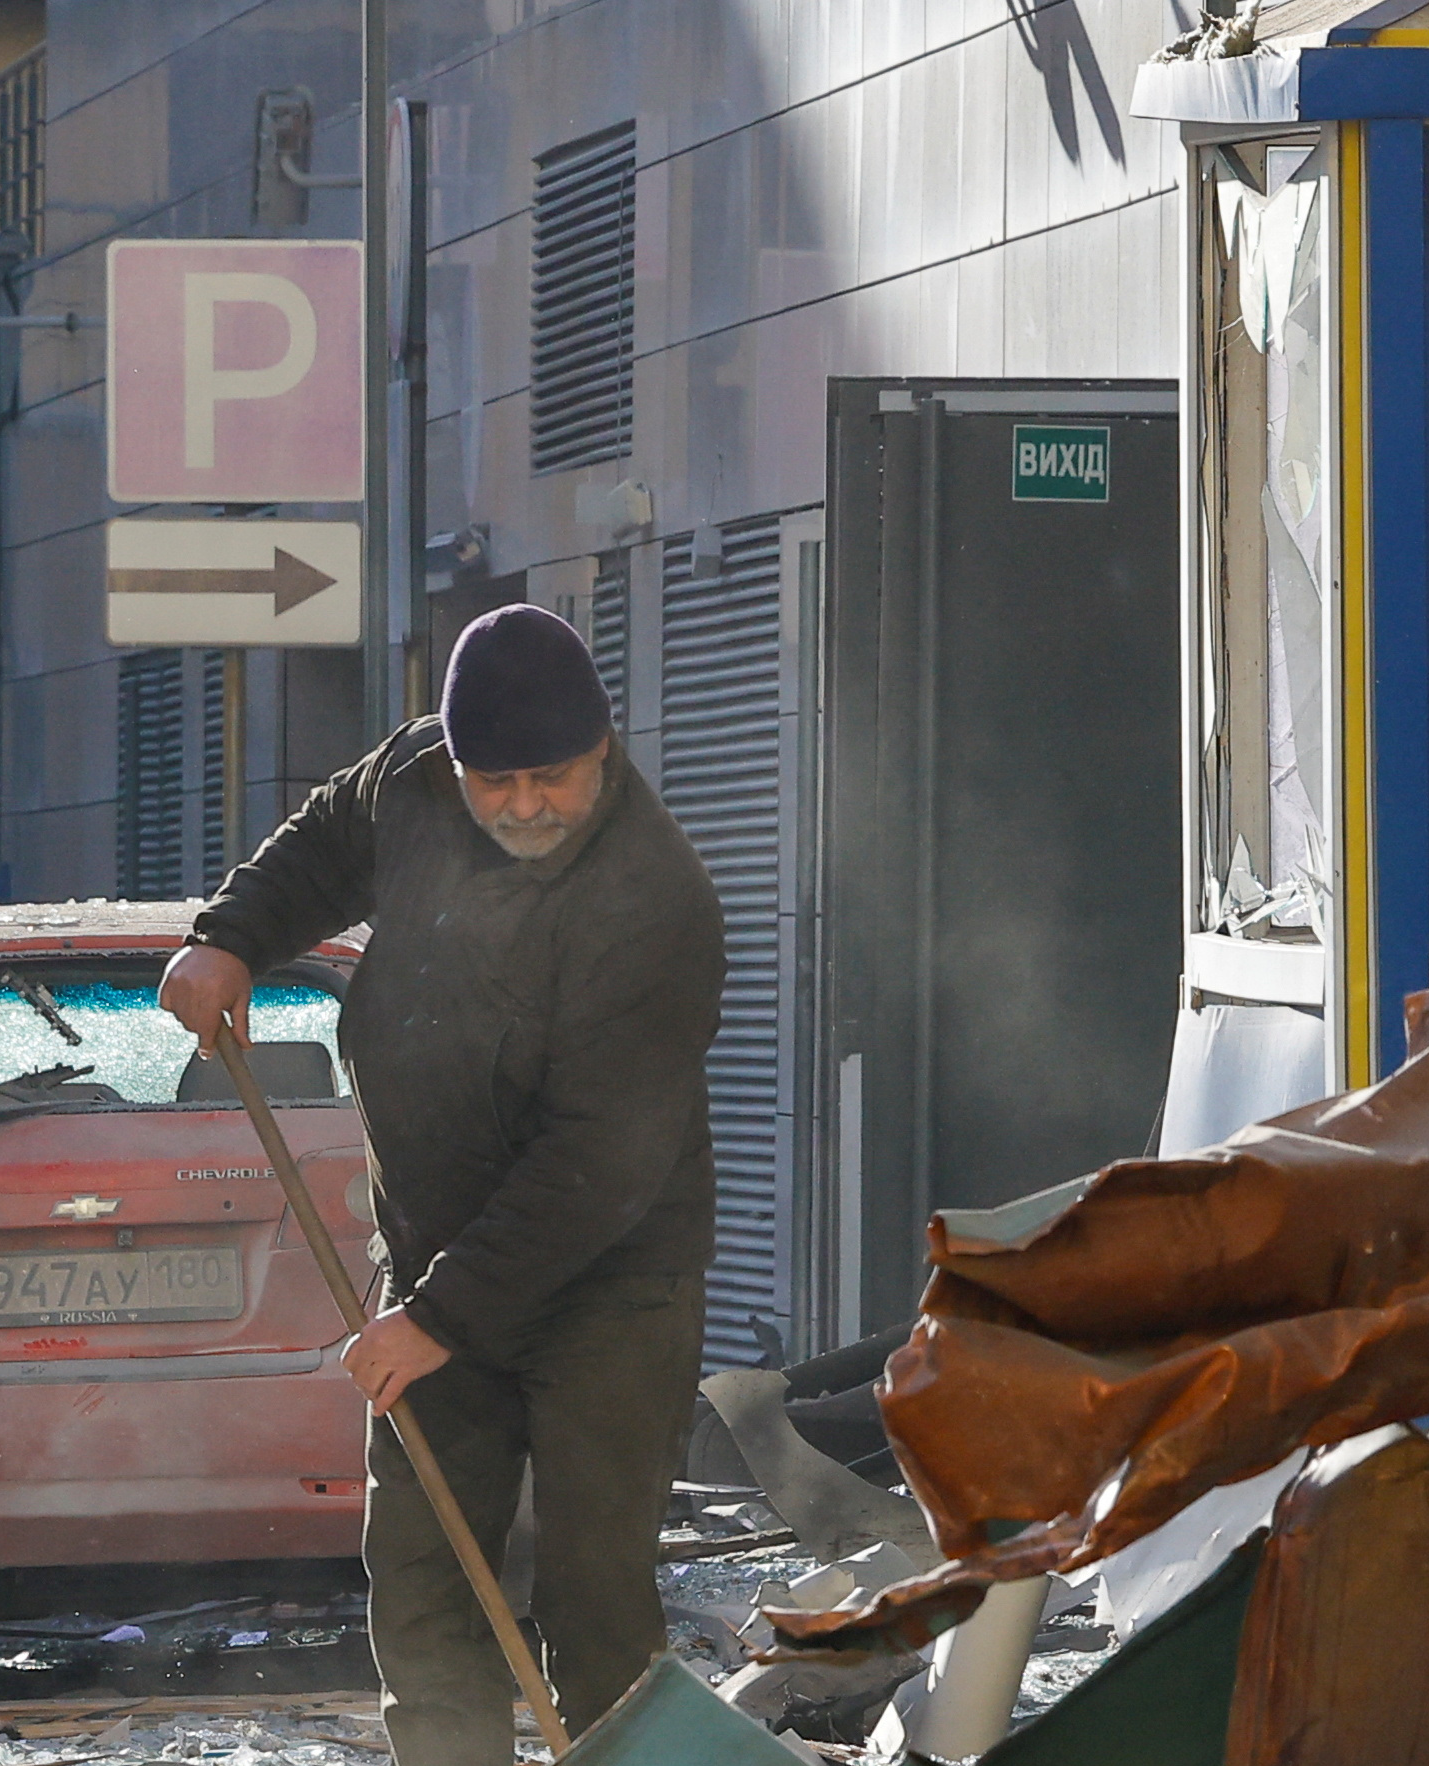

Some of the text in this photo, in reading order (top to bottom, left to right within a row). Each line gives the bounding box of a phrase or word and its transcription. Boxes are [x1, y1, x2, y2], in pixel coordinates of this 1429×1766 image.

[184, 272, 317, 469] P
[1019, 442, 1105, 485] ВИХІД
[177, 1167, 277, 1181] CHEVROLE
[154, 1254, 222, 1290] 180
[59, 1311, 117, 1323] RUSSIA
